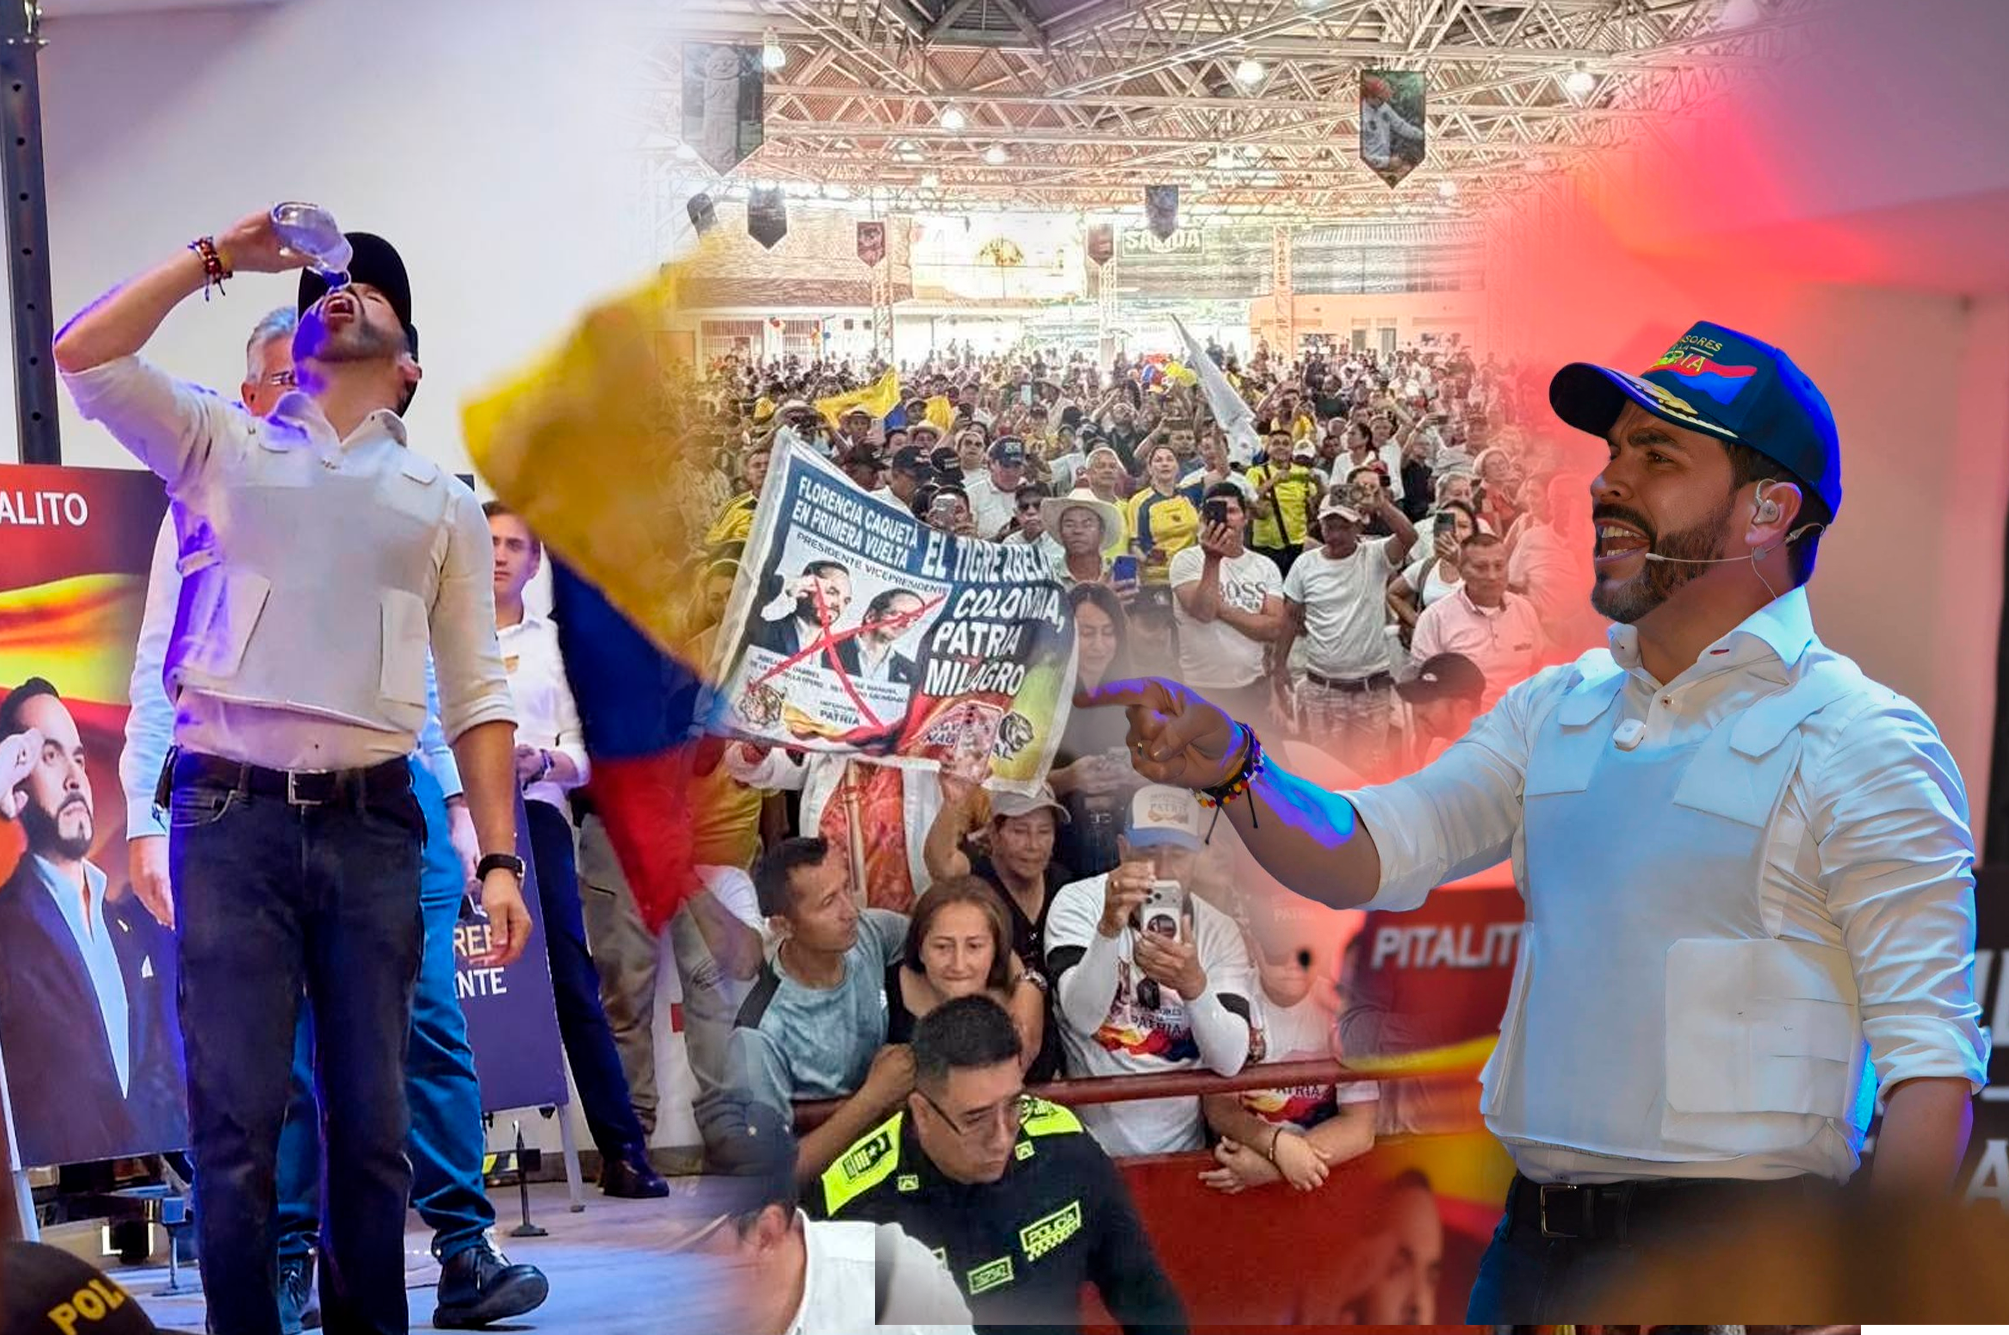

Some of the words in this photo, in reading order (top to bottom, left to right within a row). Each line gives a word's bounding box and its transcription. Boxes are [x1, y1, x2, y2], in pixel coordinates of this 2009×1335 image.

[0, 491, 88, 526] ALITO
[799, 476, 862, 525] FLORENCIA
[792, 500, 811, 525] EN
[810, 508, 862, 551] PRIMERA
[864, 535, 910, 570] VUELTA
[797, 532, 862, 569] PRESIDENTE
[865, 564, 951, 595] VICEPRESIDENTE
[921, 529, 947, 580] EL
[954, 536, 1002, 583] TIGRE
[932, 621, 1023, 658] PATRIA
[923, 658, 1026, 697] MILAGRO
[820, 710, 860, 726] PATRIA
[454, 966, 507, 999] NTE
